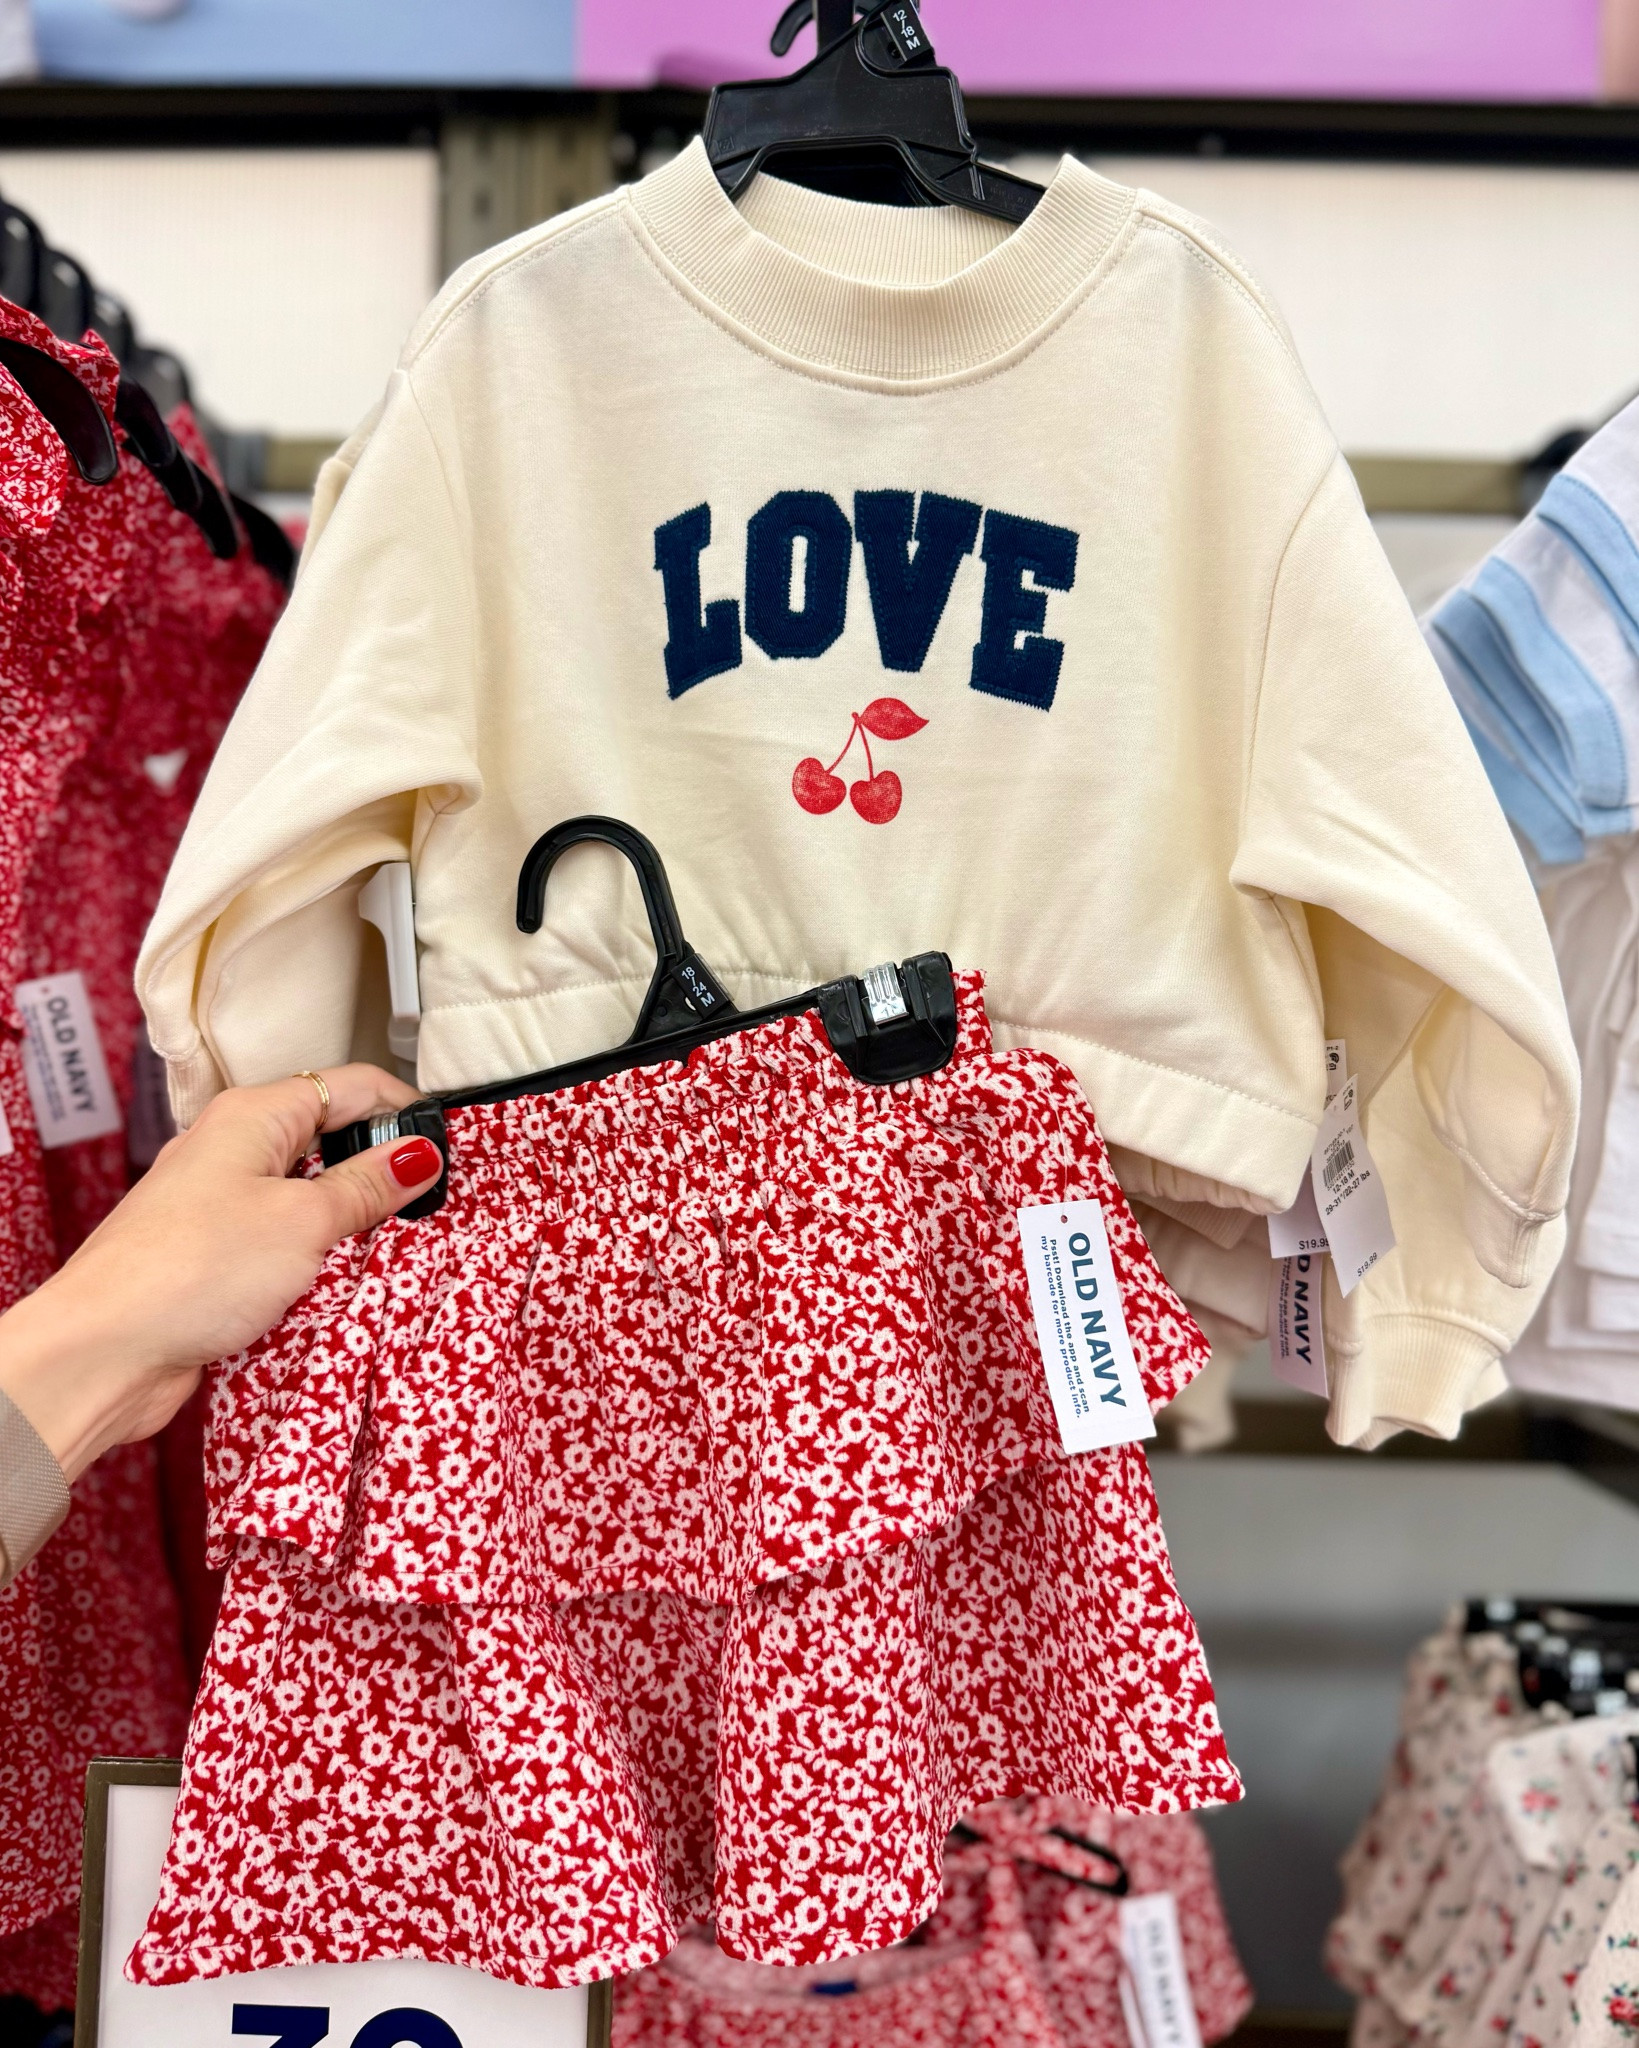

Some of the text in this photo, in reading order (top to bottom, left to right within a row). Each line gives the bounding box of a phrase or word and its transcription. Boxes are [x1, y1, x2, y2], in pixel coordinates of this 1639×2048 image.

[893, 10, 907, 21] 12
[901, 26, 915, 38] 18
[906, 36, 920, 50] M
[653, 488, 1080, 712] LOVE
[682, 966, 695, 979] 18
[692, 982, 707, 997] 24
[700, 992, 715, 1007] M
[47, 996, 76, 1043] OLD
[1360, 1170, 1370, 1181] lbs
[1357, 1252, 1378, 1277] $19.99
[1041, 1235, 1081, 1418] my barcode for more product info.
[1050, 1239, 1089, 1412] Psst! Download the app and scan
[1069, 1232, 1127, 1407] OLD NAVY
[1294, 1280, 1312, 1365] NAVY
